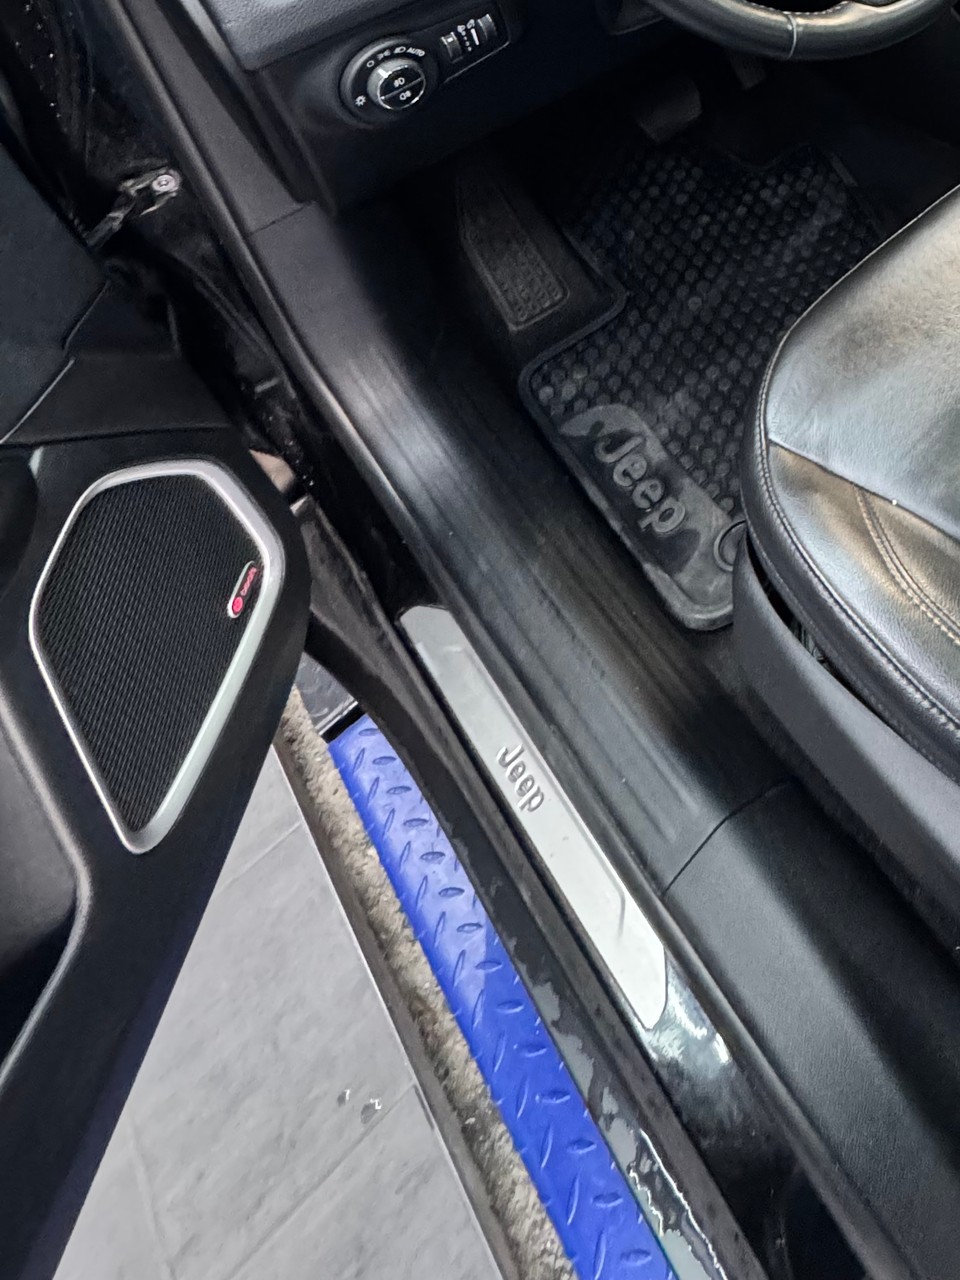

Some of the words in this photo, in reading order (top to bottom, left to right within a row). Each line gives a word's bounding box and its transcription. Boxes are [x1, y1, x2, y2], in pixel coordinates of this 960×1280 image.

[406, 46, 426, 57] AUTO
[593, 434, 686, 536] Jeep
[496, 743, 545, 813] Jeep
